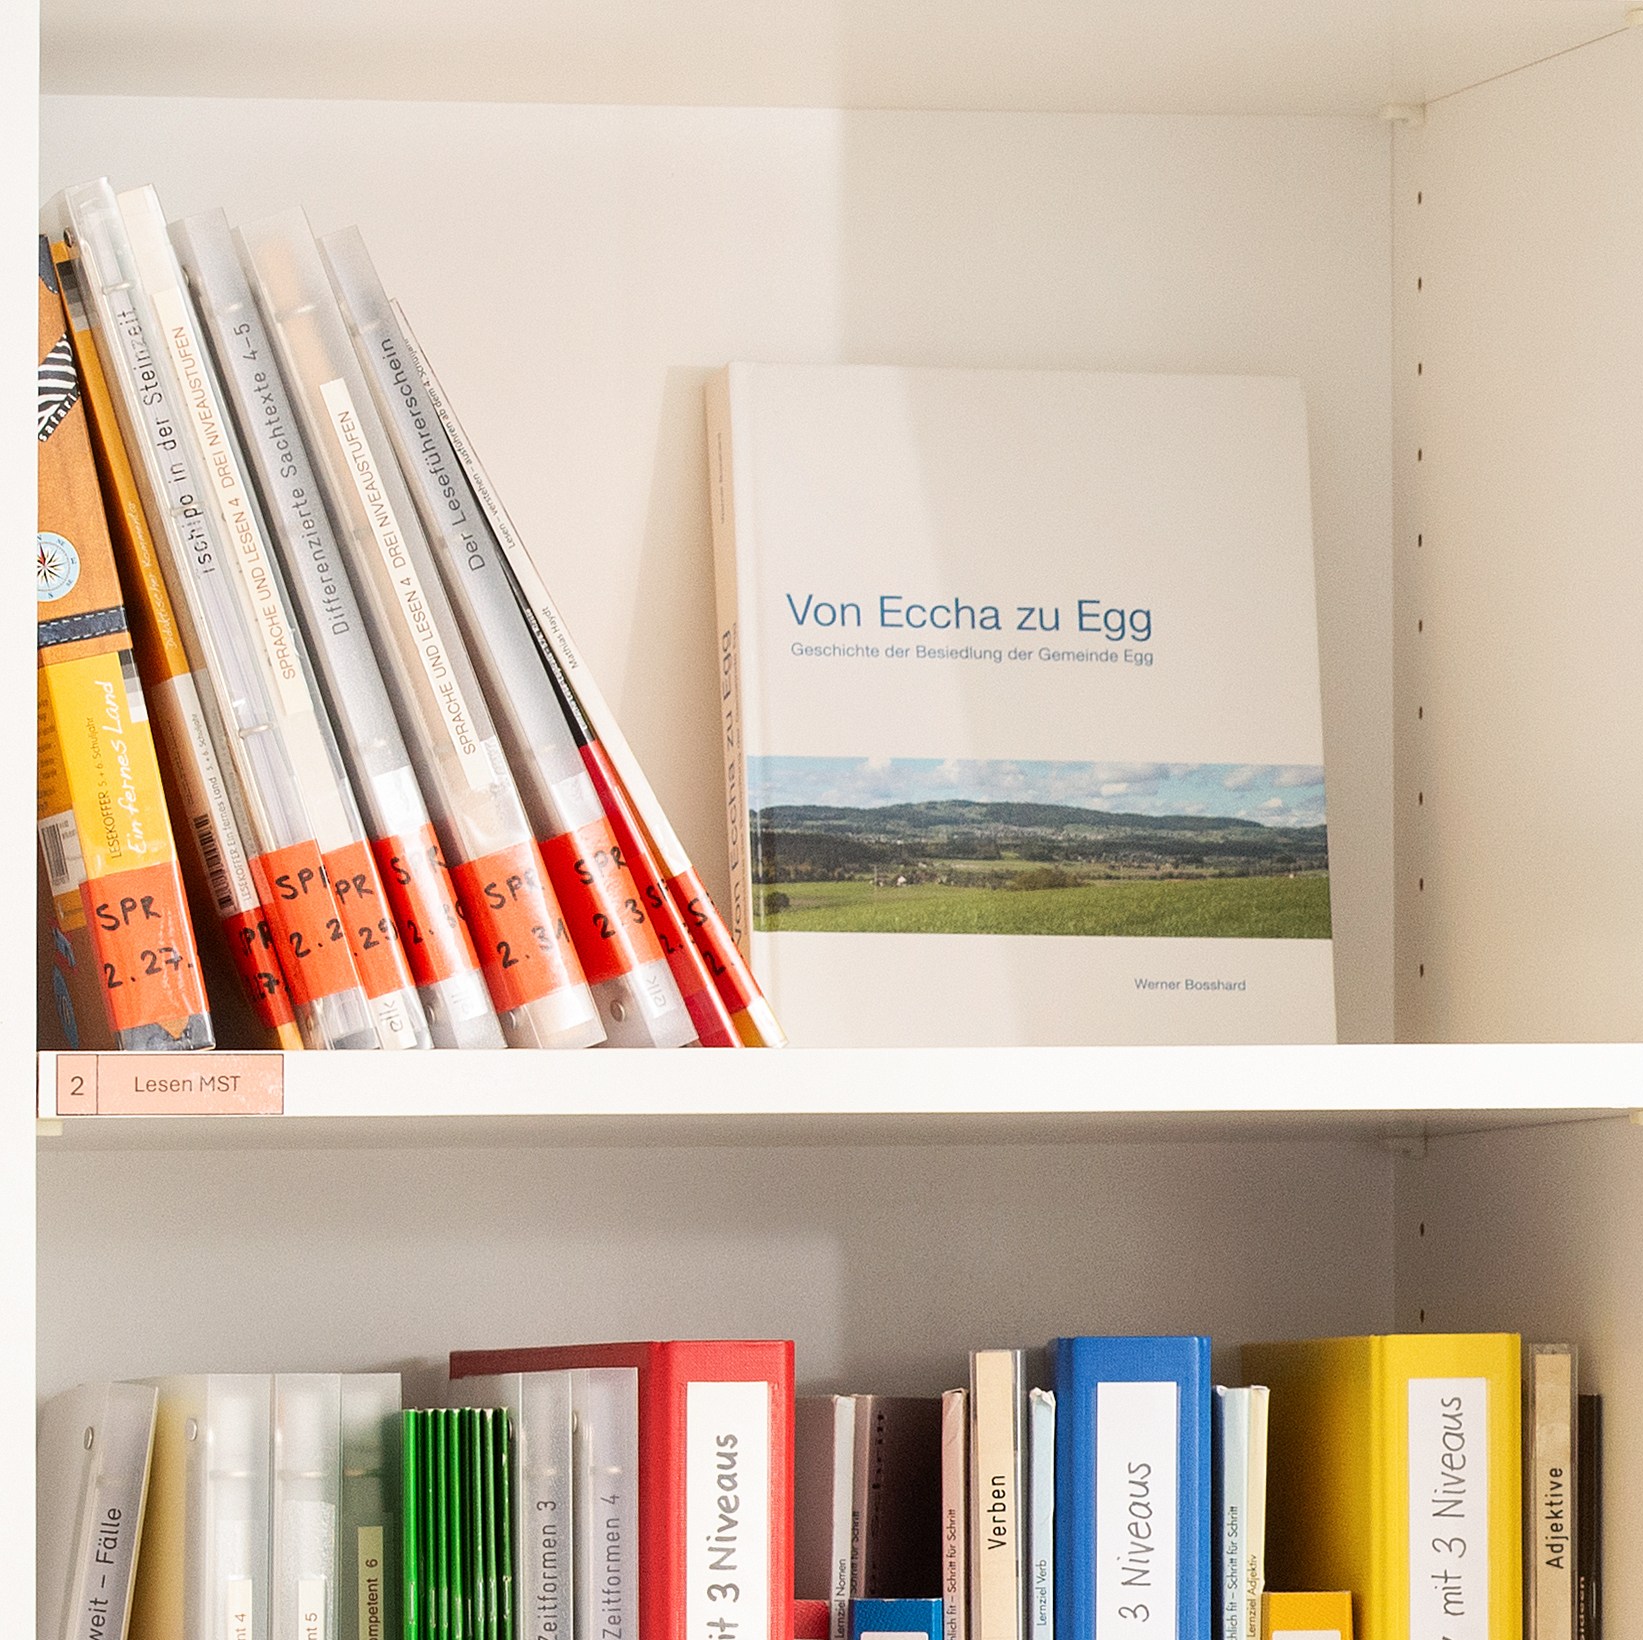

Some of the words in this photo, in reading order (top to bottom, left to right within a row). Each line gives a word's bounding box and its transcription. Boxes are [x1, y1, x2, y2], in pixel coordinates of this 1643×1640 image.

[114, 306, 165, 406] Steinzeit
[171, 324, 223, 447] NIVEAUSTUFEN
[148, 415, 178, 453] der
[248, 370, 299, 479] Sachtexte
[377, 335, 467, 527] Leseführerschein
[163, 462, 186, 484] in
[211, 449, 236, 489] DREI
[226, 495, 243, 509] 4
[229, 507, 260, 563] LESEN
[457, 529, 486, 571] Der
[285, 486, 350, 636] Differenzierte
[248, 565, 272, 601] UND
[539, 605, 562, 634] Haydt
[787, 594, 861, 628] Von
[880, 596, 1001, 631] Eccha
[1016, 606, 1060, 632] zu
[1077, 600, 1153, 642] Egg
[260, 604, 298, 681] SPRACHE
[553, 632, 579, 670] Mathias
[790, 642, 880, 659] Geschichte
[884, 643, 910, 660] der
[915, 644, 1002, 663] Besiedlung
[1007, 645, 1033, 662] der
[1038, 646, 1118, 664] Gemeinde
[1123, 649, 1154, 667] Egg
[94, 677, 123, 736] Land
[107, 740, 138, 816] fernes
[123, 819, 147, 856] Ein
[574, 846, 628, 886] SPR
[96, 896, 161, 932] SPR
[1134, 977, 1180, 992] Werner
[1184, 978, 1246, 992] Bosshard
[70, 1076, 84, 1096] 2
[134, 1076, 193, 1093] Lesen
[199, 1075, 241, 1092] MST
[1431, 1396, 1466, 1517] Niveaus
[536, 1500, 556, 1510] 3
[706, 1434, 739, 1570] Niveaus
[987, 1475, 1006, 1549] Verben
[1545, 1467, 1568, 1568] Adjektive
[94, 1506, 123, 1565] Fälle
[946, 1508, 956, 1540] Schritt
[1117, 1462, 1154, 1585] Niveaus
[366, 1558, 379, 1567] 6
[946, 1544, 957, 1558] für
[1432, 1536, 1466, 1556] 3
[836, 1558, 846, 1595] Nomen
[946, 1560, 956, 1592] Schritt
[1036, 1559, 1047, 1583] Verb
[706, 1583, 740, 1602] 3
[946, 1604, 956, 1614] fit
[1036, 1586, 1047, 1625] Lernziel
[1431, 1569, 1464, 1614] mit
[233, 1612, 246, 1622] 4
[835, 1599, 846, 1638] Lernziel
[1118, 1604, 1149, 1622] 3
